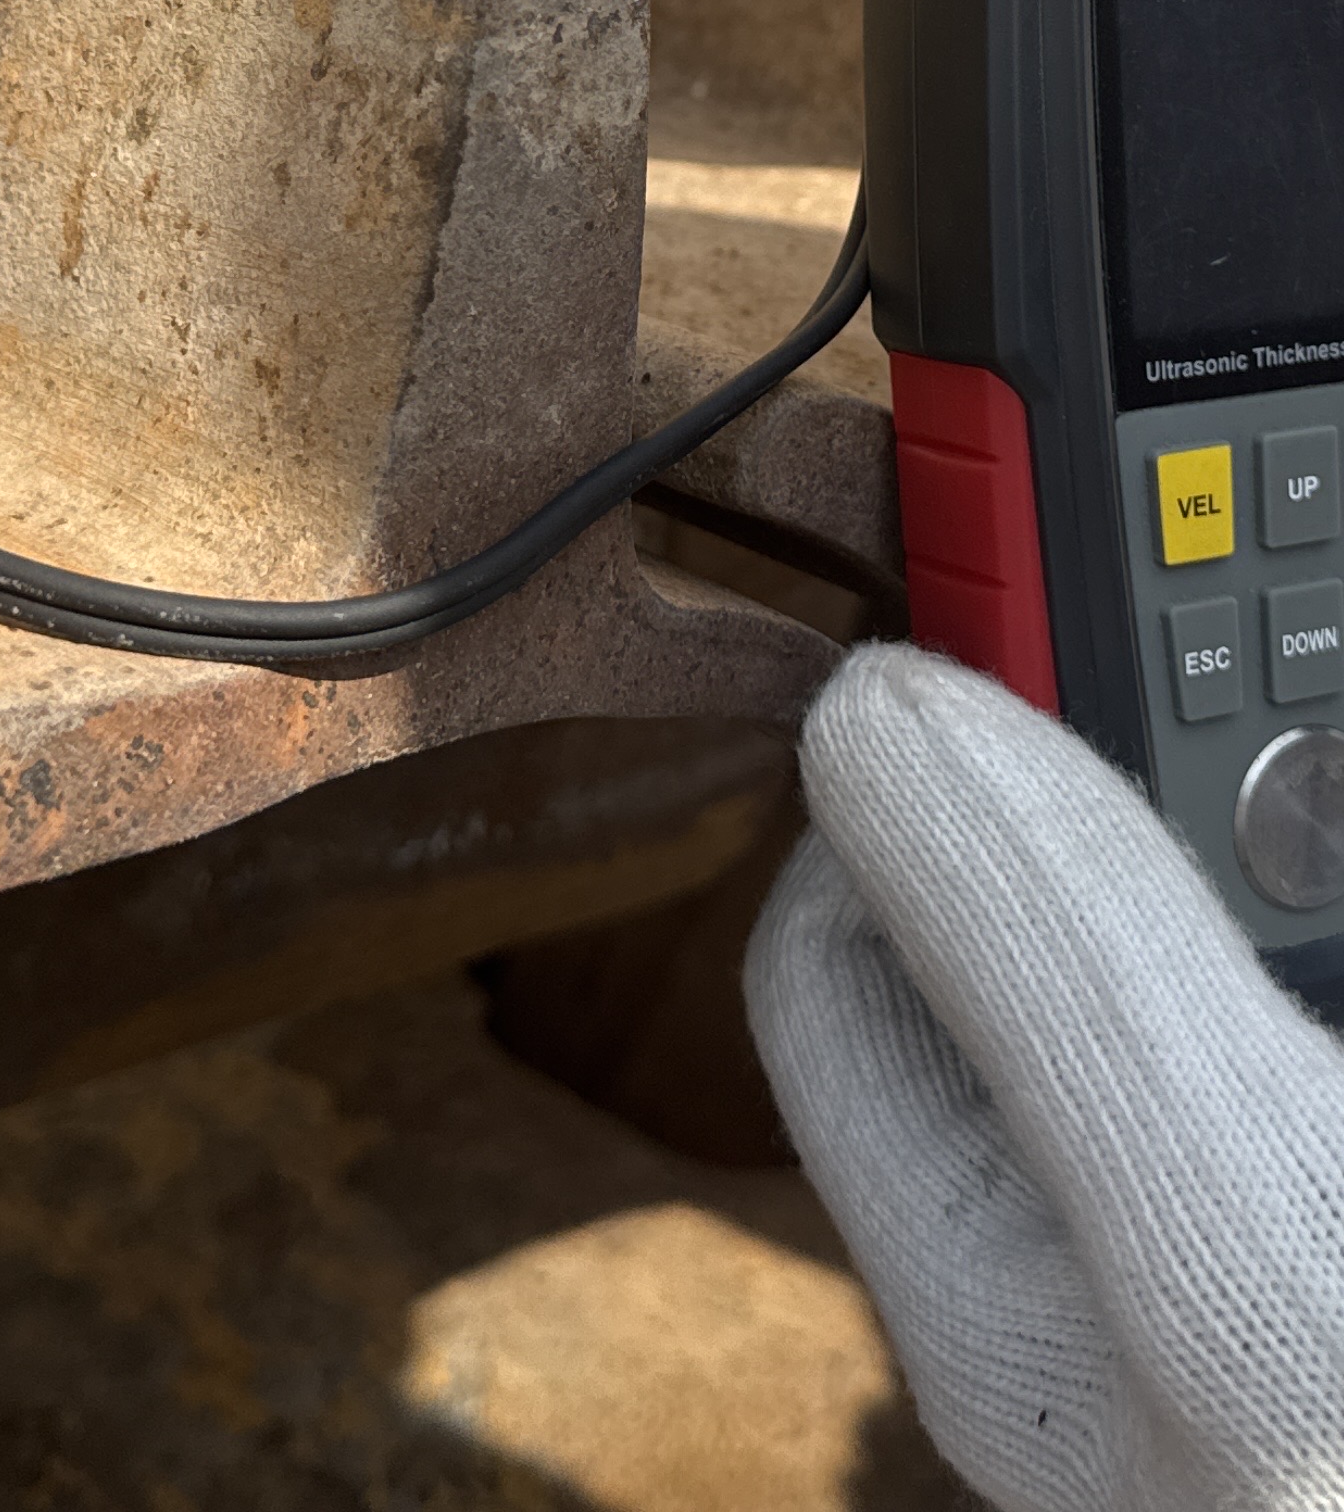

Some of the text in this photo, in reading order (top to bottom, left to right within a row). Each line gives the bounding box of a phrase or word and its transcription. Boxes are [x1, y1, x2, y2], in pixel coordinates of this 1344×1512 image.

[1145, 351, 1249, 382] Ultrasonic
[1288, 475, 1319, 501] UP
[1177, 494, 1221, 518] VEL
[1282, 627, 1338, 657] DOWN
[1185, 647, 1230, 675] ESC
